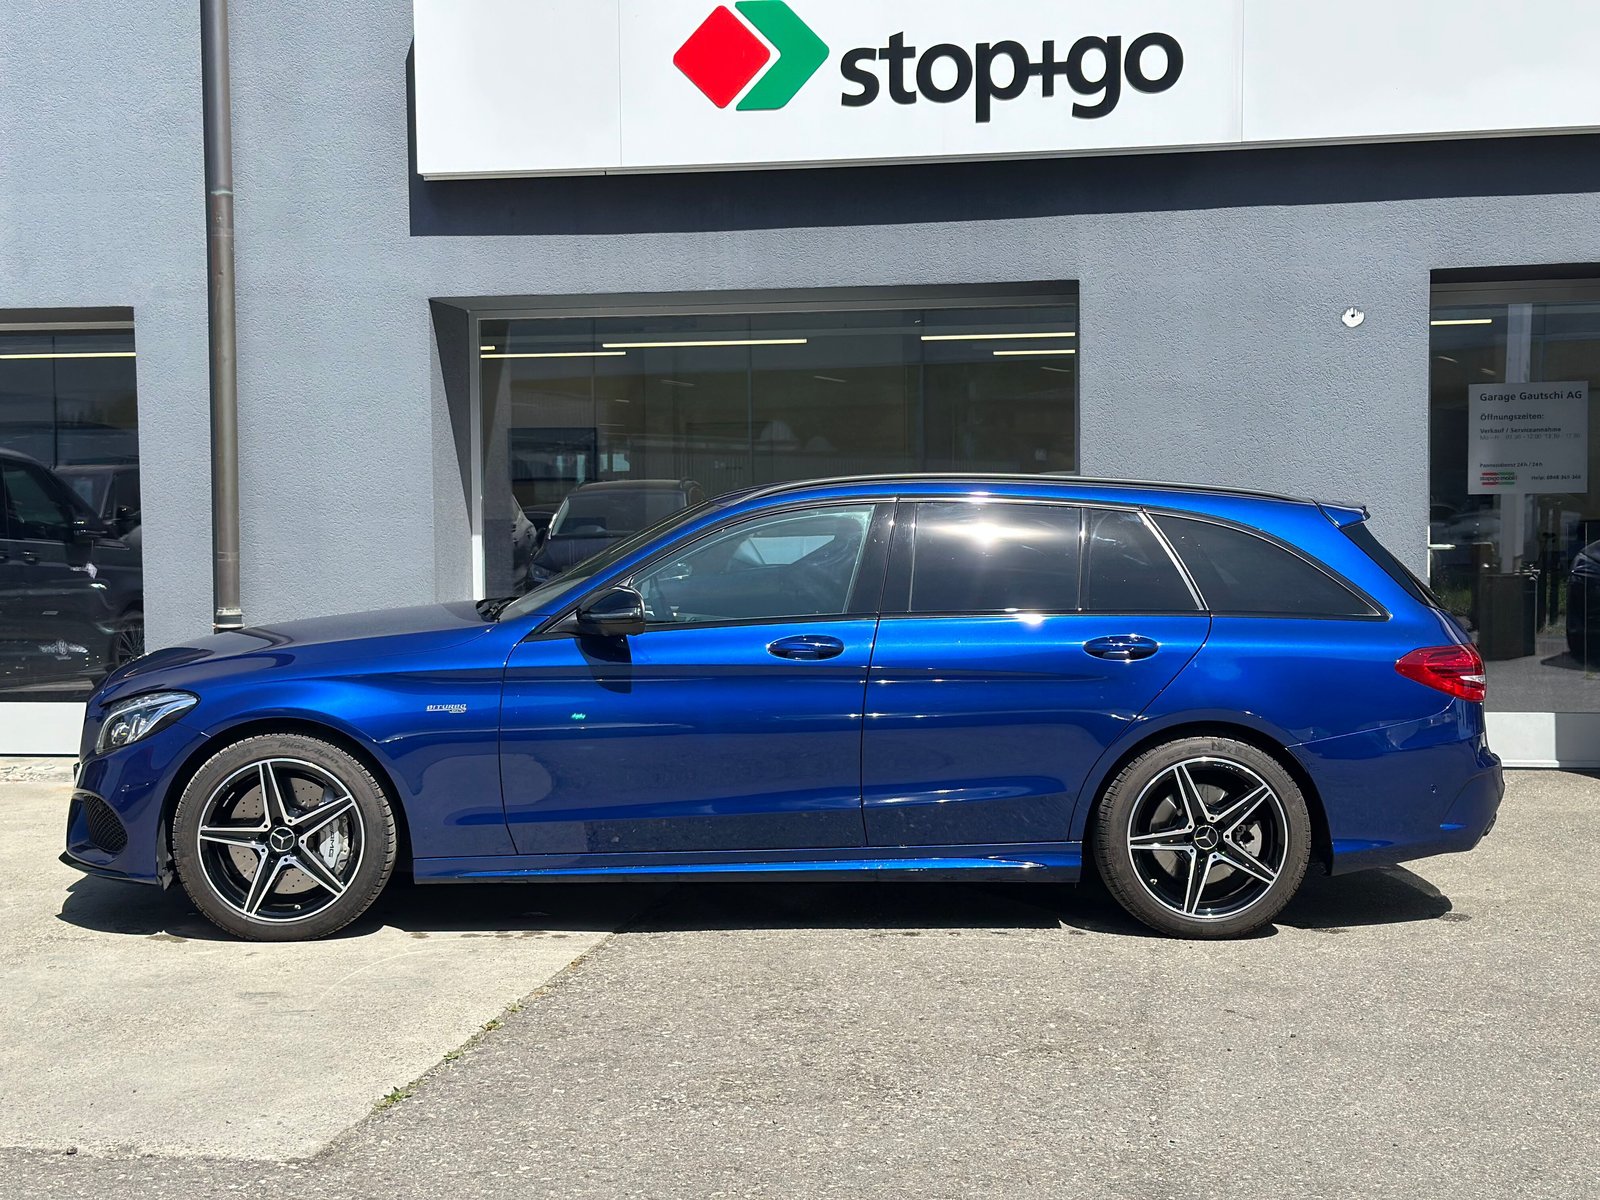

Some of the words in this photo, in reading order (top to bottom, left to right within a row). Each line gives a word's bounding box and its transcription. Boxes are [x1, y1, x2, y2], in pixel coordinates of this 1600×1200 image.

[840, 31, 1184, 123] stop+go
[1479, 392, 1516, 403] Garage
[1519, 390, 1563, 401] Gautschi
[1566, 390, 1583, 399] AG
[1480, 413, 1544, 422] Öffnungszeiten:
[426, 703, 467, 712] BITURBO
